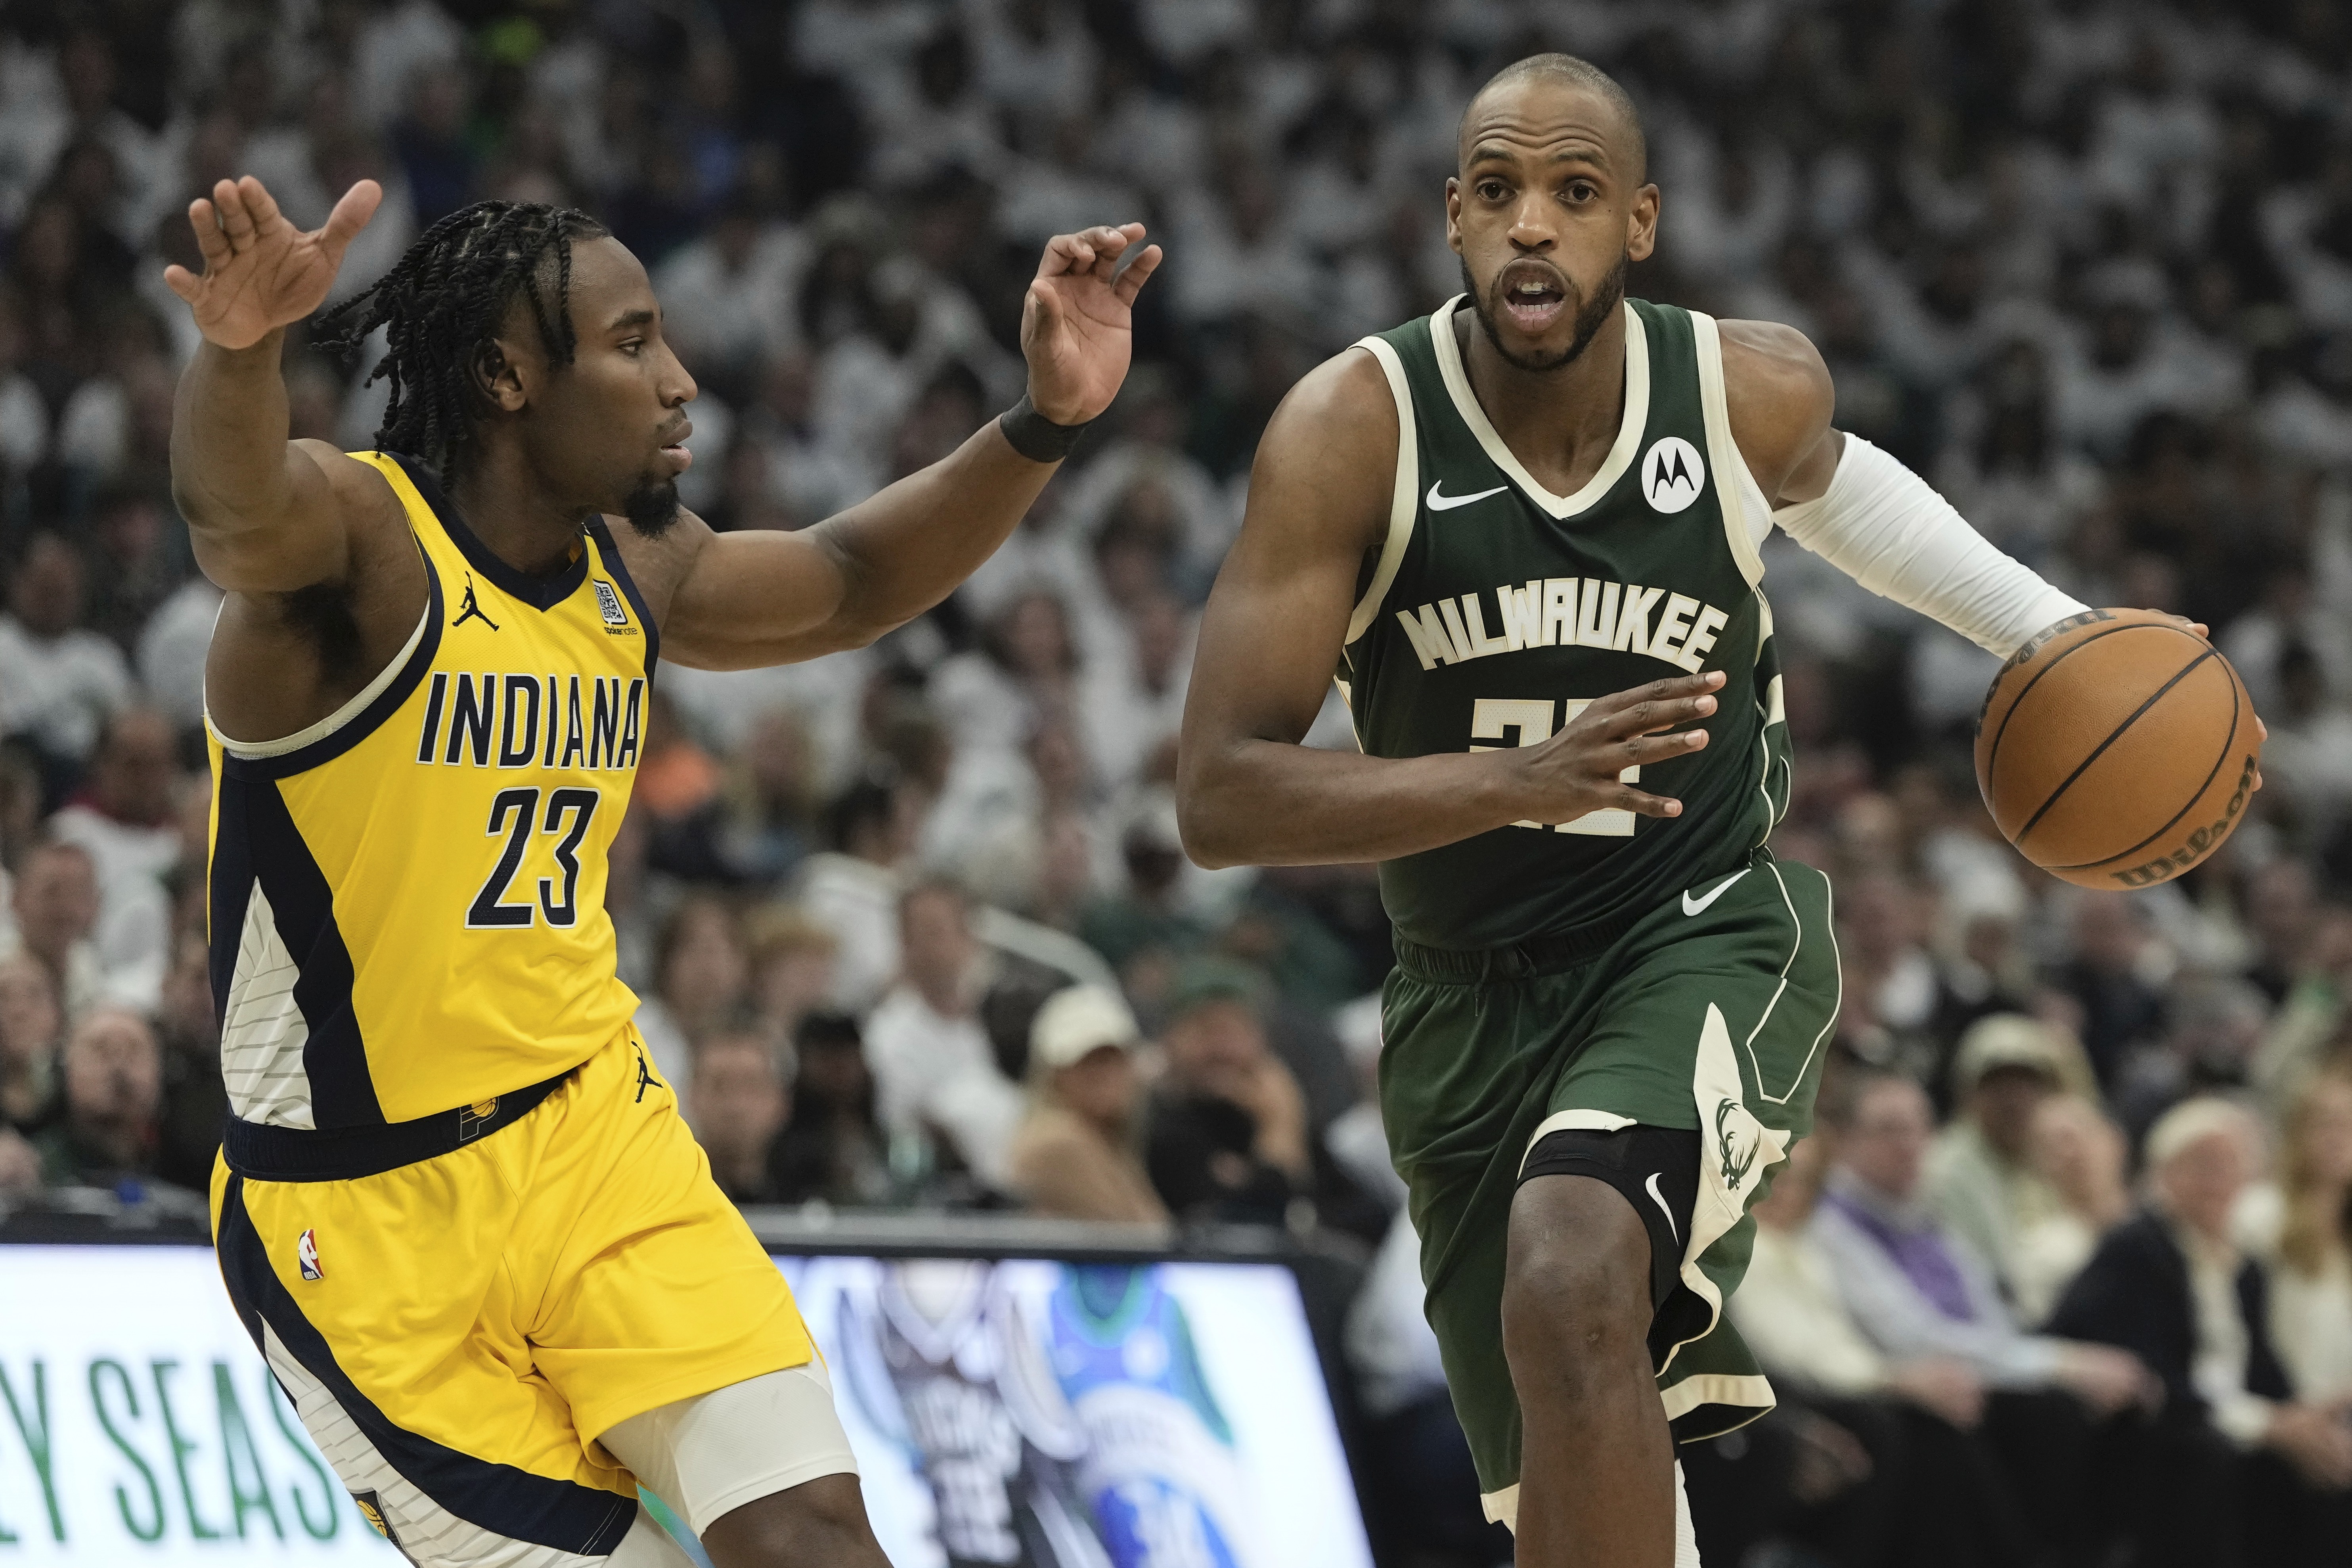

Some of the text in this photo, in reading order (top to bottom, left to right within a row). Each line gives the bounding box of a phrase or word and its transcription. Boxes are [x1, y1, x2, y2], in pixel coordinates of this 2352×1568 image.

[604, 626, 637, 636] spokenote
[1396, 577, 1729, 674] MILWAUKEE
[416, 671, 645, 770] INDIANA
[465, 786, 601, 929] 23
[2110, 754, 2256, 886] Wilson
[304, 1270, 317, 1280] NBA
[0, 1359, 388, 1542] Y SEAS
